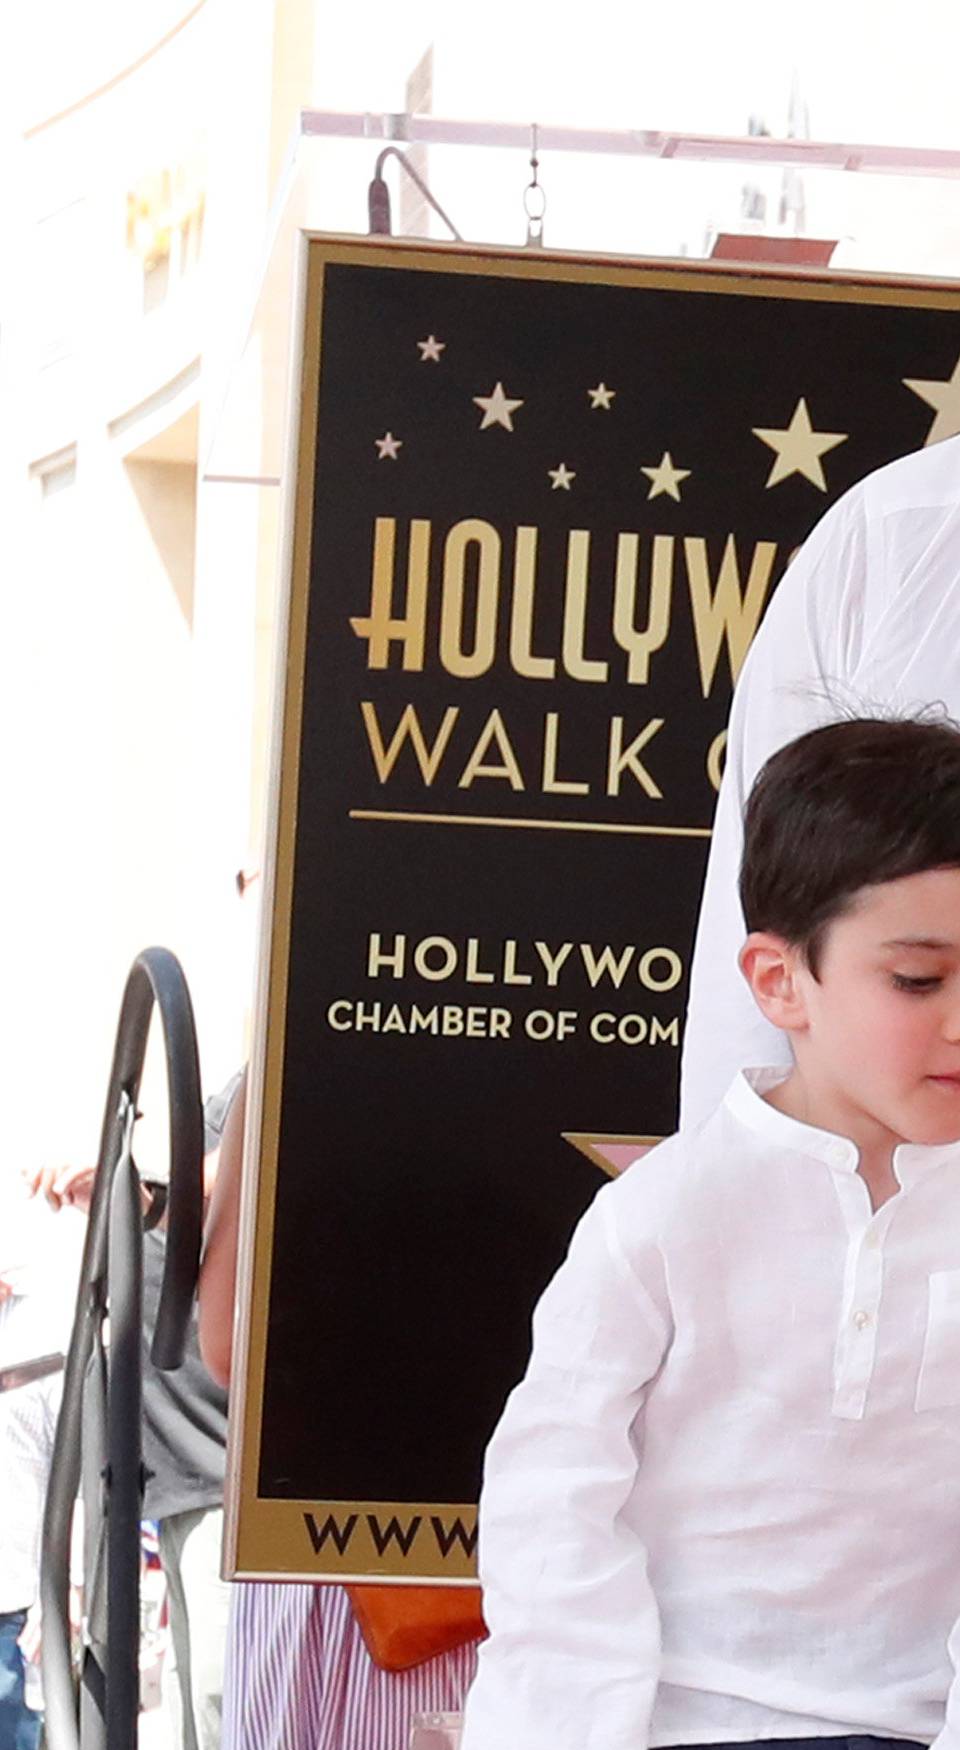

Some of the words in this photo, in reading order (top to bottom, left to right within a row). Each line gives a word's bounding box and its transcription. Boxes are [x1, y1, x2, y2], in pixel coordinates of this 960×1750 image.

[350, 515, 801, 699] HOLLYW
[361, 702, 665, 799] WALK
[367, 932, 683, 992] HOLLYWO
[327, 1000, 512, 1039] CHAMBER
[524, 1009, 578, 1041] OF
[589, 1012, 681, 1047] COM
[303, 1512, 478, 1559] WWW
